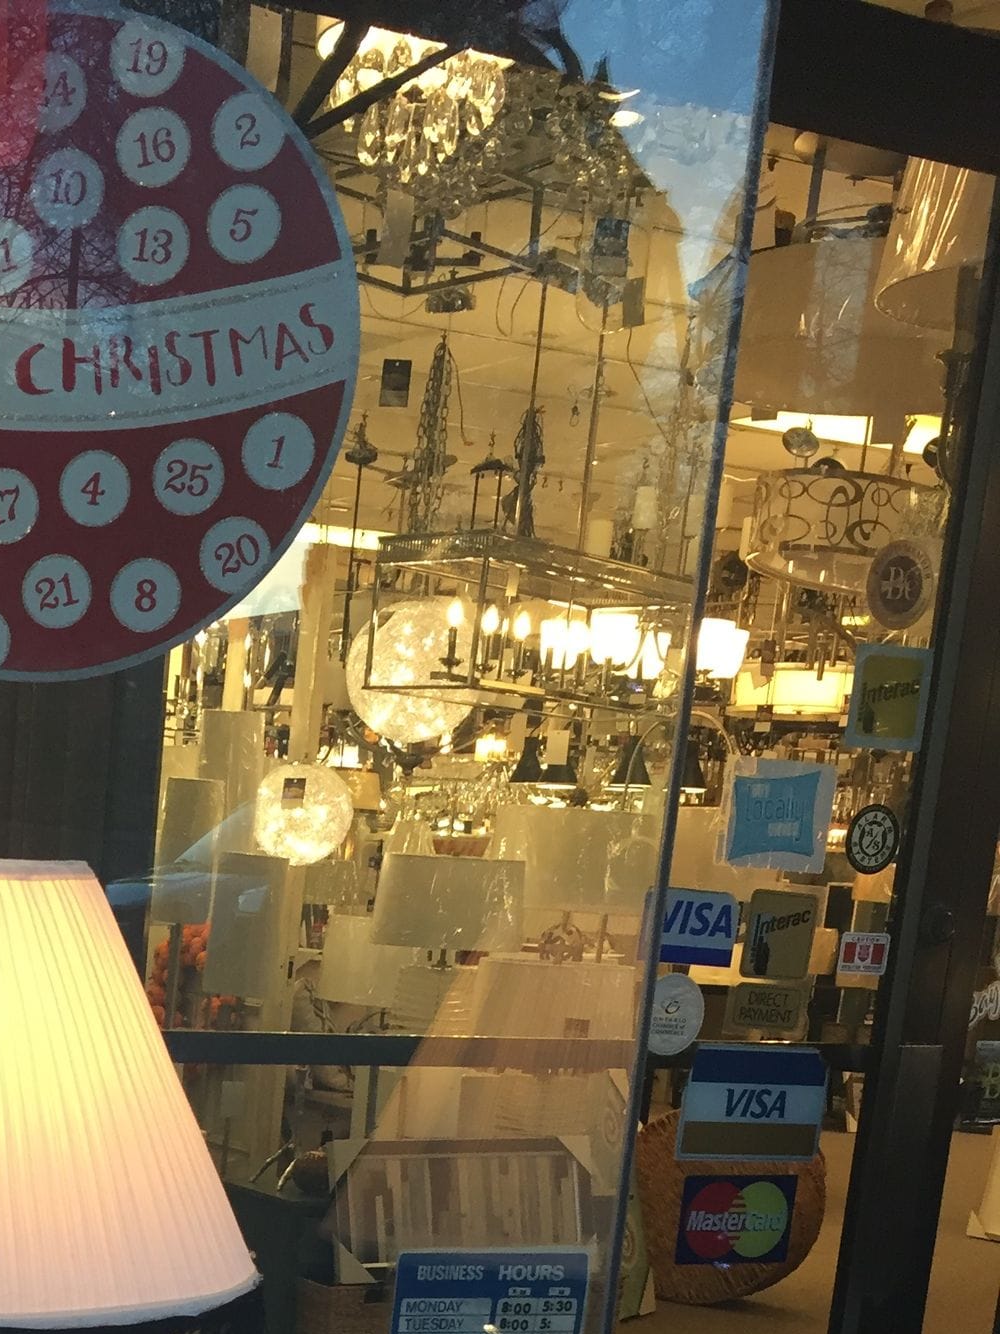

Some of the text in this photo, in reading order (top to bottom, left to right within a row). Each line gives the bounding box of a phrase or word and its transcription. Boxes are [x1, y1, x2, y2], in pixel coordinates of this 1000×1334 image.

[126, 39, 168, 74] 19
[137, 125, 177, 169] 16
[236, 113, 262, 151] 2
[50, 171, 88, 207] 10
[229, 207, 259, 242] 5
[134, 227, 174, 263] 13
[15, 302, 336, 396] CHRISTMAS
[266, 436, 286, 470] 1
[80, 472, 107, 506] 4
[164, 458, 211, 497] 25
[215, 535, 261, 577] 20
[35, 574, 80, 611] 21
[135, 579, 158, 613] 8
[665, 900, 733, 938] VISA
[753, 910, 811, 946] Interac
[740, 1006, 793, 1024] PAYMENT
[748, 990, 789, 1008] DIRECT
[724, 1088, 787, 1120] VISA
[686, 1210, 786, 1232] MasterCard
[417, 1264, 566, 1281] BUSINESS HOURS
[405, 1301, 463, 1314] MONDAY
[405, 1318, 464, 1330] TUESDAY
